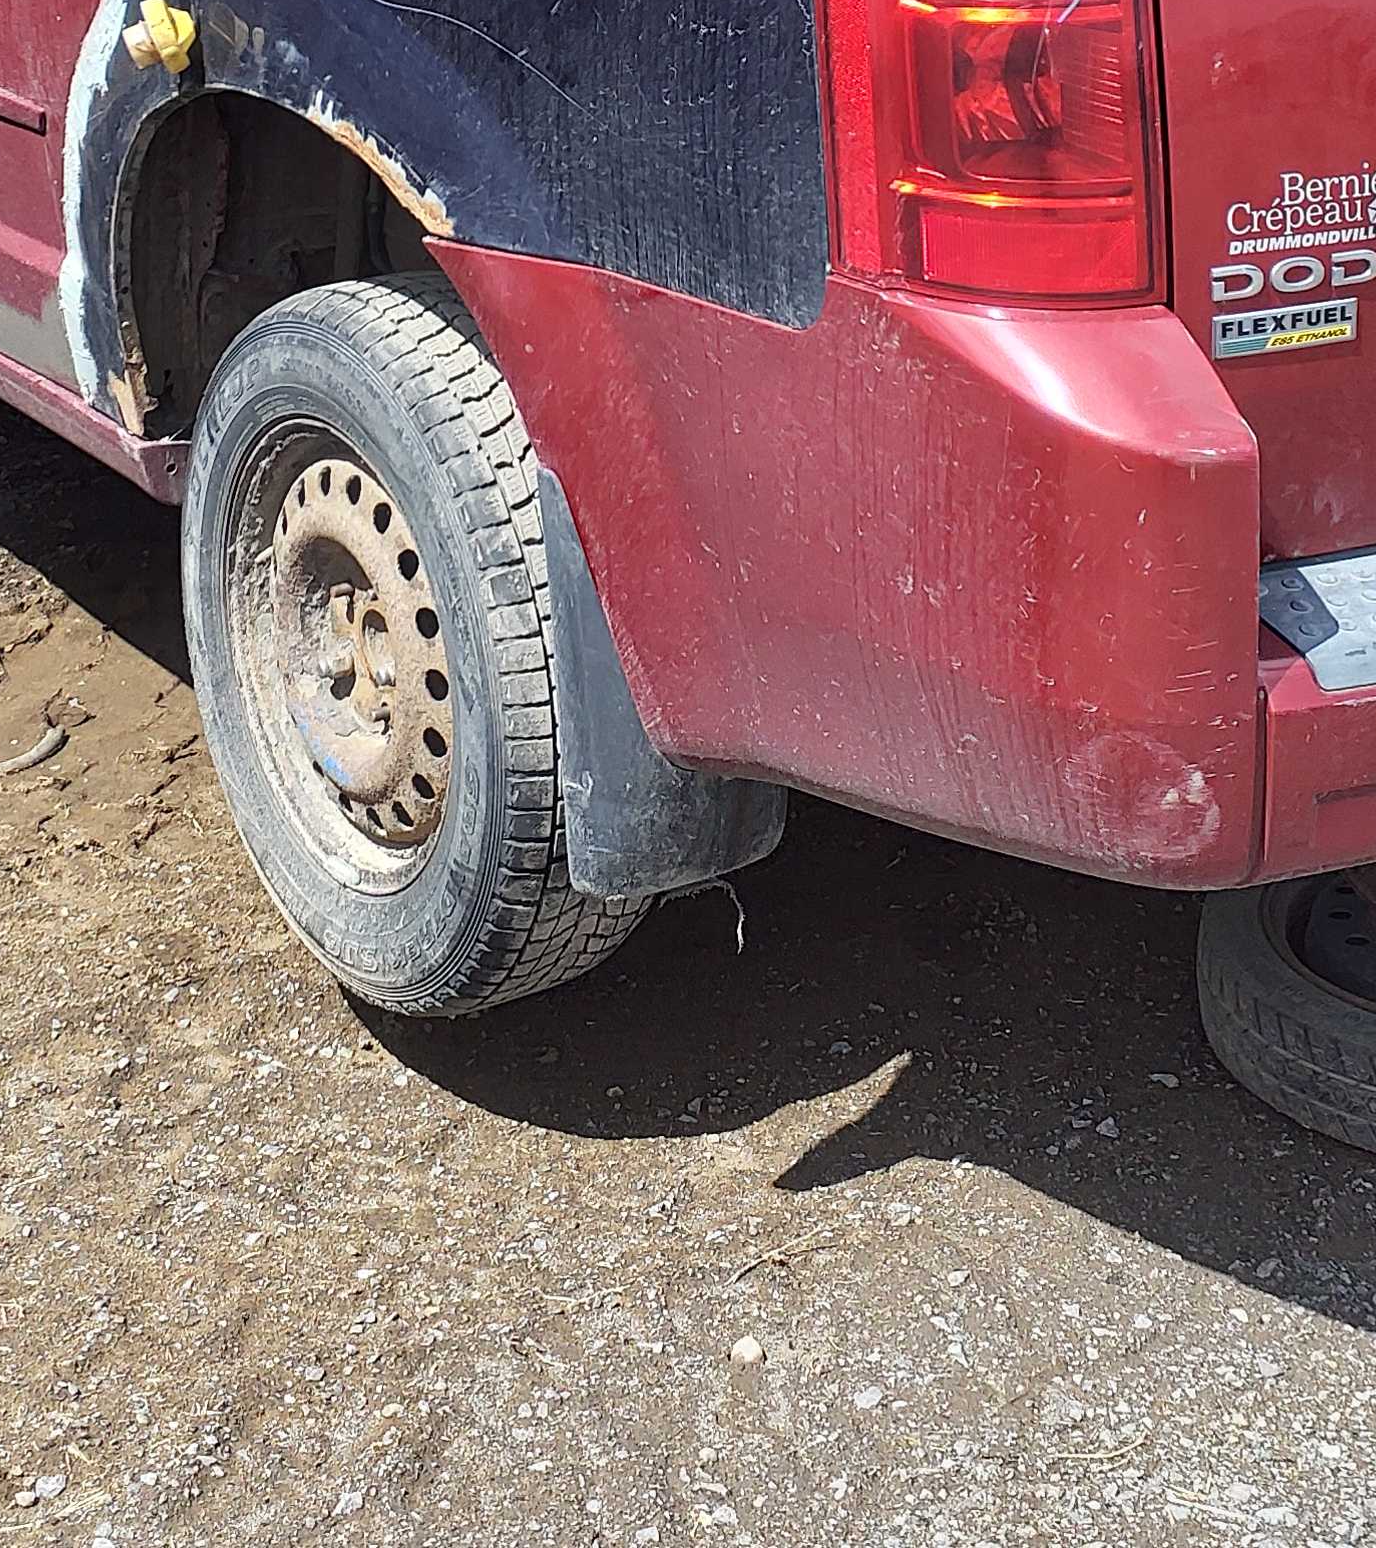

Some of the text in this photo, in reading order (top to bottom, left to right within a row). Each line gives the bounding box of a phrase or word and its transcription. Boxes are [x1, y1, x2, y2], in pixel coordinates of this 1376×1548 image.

[1226, 197, 1364, 235] Crépeau
[1221, 305, 1353, 339] FLEXFUEL
[1270, 327, 1349, 347] E85 ETHANOL
